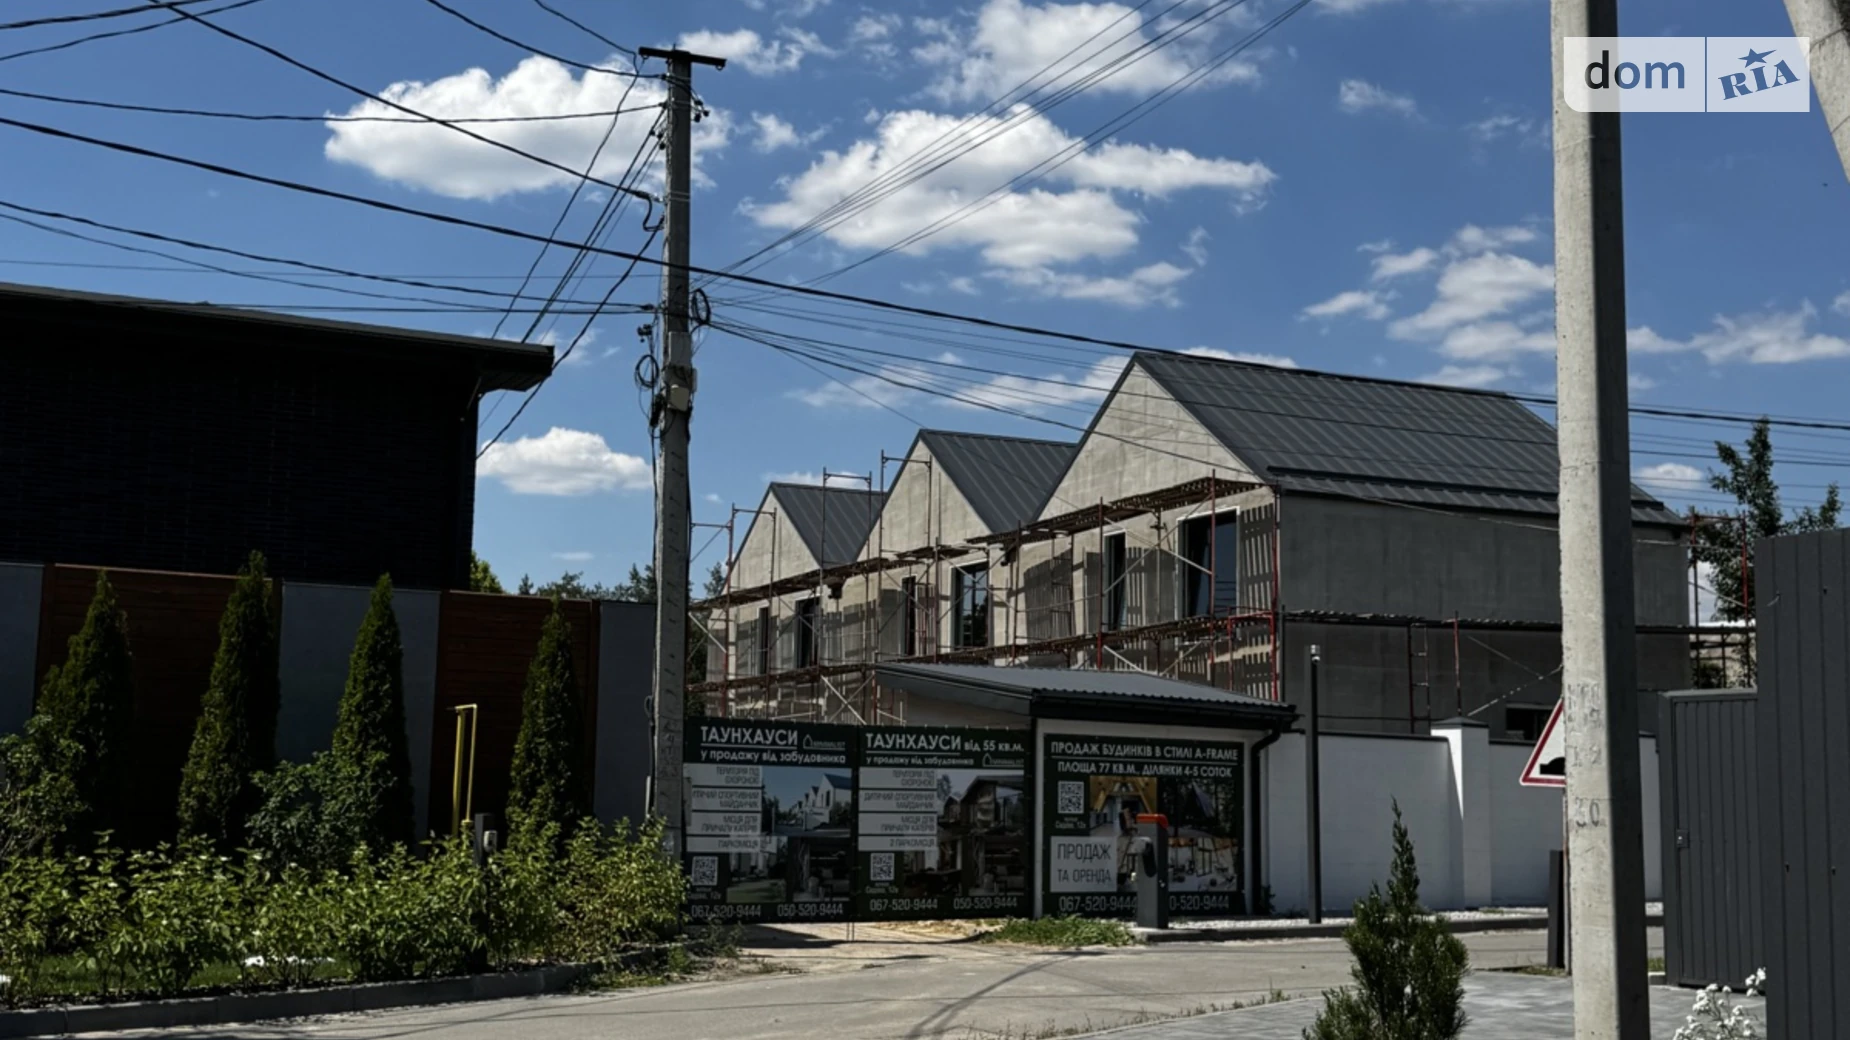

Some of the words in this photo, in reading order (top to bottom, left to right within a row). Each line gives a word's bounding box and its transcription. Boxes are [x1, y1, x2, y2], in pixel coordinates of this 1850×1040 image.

[700, 726, 799, 746] ТАУНХАУСИ
[865, 732, 962, 750] ТАУНХАУСИ
[963, 738, 982, 752] від
[983, 740, 997, 752] 55
[998, 742, 1025, 753] кв.м.
[700, 750, 709, 761] у
[710, 750, 760, 763] продажу
[762, 750, 778, 763] від
[780, 751, 847, 764] забудовника
[1050, 741, 1101, 756] ПРОДАЖ
[1102, 743, 1153, 758] БУДИНКІВ
[1154, 746, 1162, 758] В
[1163, 747, 1193, 760] СТИЛІ
[1194, 748, 1239, 761] A-FRAME
[866, 756, 873, 766] у
[874, 756, 909, 767] продажу
[911, 755, 923, 766] від
[925, 756, 975, 767] забудовника
[1057, 761, 1097, 774] ПЛОЩА
[1098, 762, 1110, 774] 77
[1141, 764, 1183, 777] ДІЛЯНКИ
[1184, 765, 1199, 778] 4-5
[1200, 765, 1233, 778] СОТОК
[1057, 842, 1112, 863] ПРОДАЖ
[1057, 868, 1069, 883] ТА
[1072, 868, 1112, 885] ОРЕНДА
[776, 902, 844, 917] 050-520-9444
[869, 898, 939, 912] 067-520-9444
[952, 896, 1018, 910] 050-520-9444
